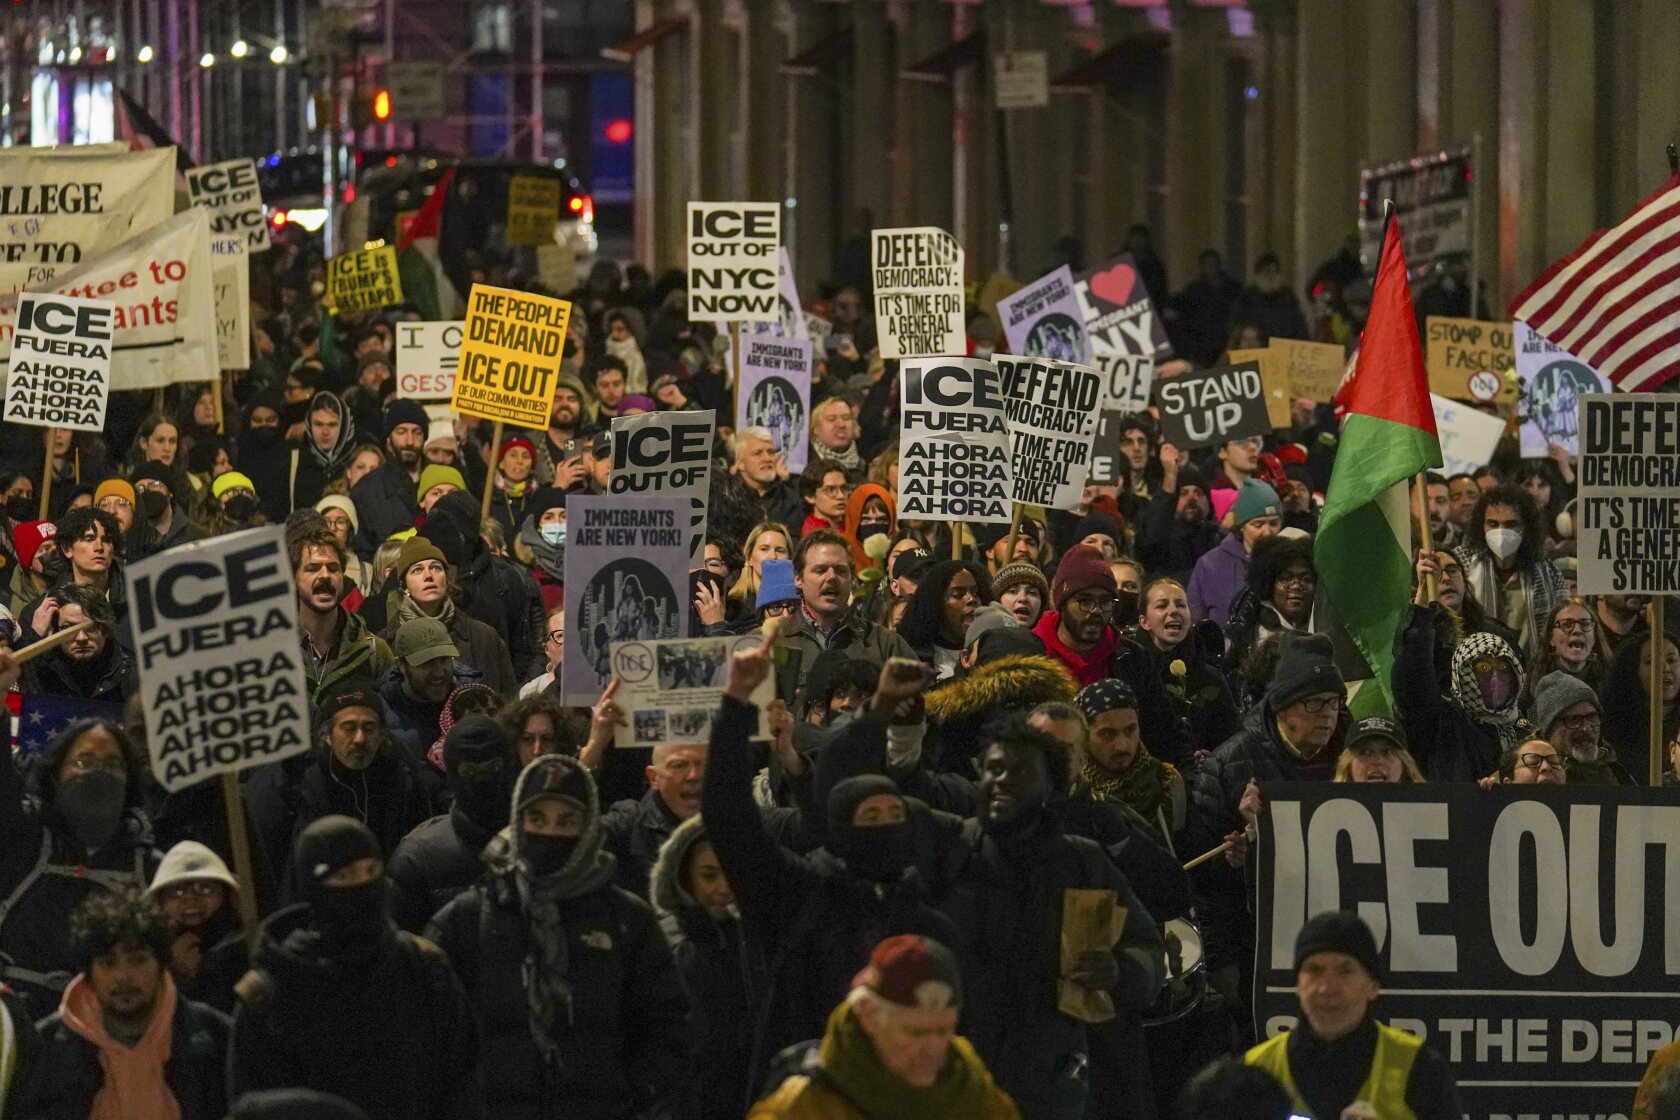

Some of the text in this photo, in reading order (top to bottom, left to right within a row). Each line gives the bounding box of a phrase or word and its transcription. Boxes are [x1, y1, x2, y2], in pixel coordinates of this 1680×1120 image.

[189, 164, 256, 197] ICE
[0, 182, 103, 216] LLEGE
[232, 189, 257, 203] OF
[692, 209, 777, 238] ICE
[692, 242, 776, 257] OUT OF
[877, 233, 958, 268] DEFEND
[27, 266, 55, 283] FOR
[149, 260, 186, 284] to
[333, 253, 370, 276] ICE
[692, 268, 776, 290] NYC
[875, 266, 959, 288] DEMOCRACY:
[475, 292, 566, 329] THE PEOPLE
[692, 295, 776, 313] NOW
[879, 294, 960, 316] IT'S TIME FOR
[18, 299, 112, 340] ICE
[889, 314, 953, 336] A GENERAL
[1088, 311, 1156, 355] NY
[1428, 322, 1482, 342] STOMP
[14, 335, 108, 360] FUERA
[469, 315, 560, 358] DEMAND
[751, 342, 803, 360] IMMIGRANTS
[898, 335, 945, 355] STRIKE!
[1522, 341, 1564, 353] ARE NE
[13, 361, 105, 382] AHORA
[462, 351, 554, 398] ICE OUT
[746, 355, 807, 372] ARE NEW YORK!
[9, 390, 101, 411] AHORA
[11, 376, 103, 397] AHORA
[458, 384, 548, 413] OF OUR COMMUNITIES!
[905, 365, 1004, 408] ICE
[998, 360, 1100, 412] DEFEND
[1160, 370, 1260, 415] STAND
[8, 404, 99, 426] AHORA
[904, 410, 1009, 435] FUERA
[1004, 397, 1093, 436] MOCRACY:
[1183, 402, 1242, 442] UP
[1586, 401, 1680, 455] DEFE
[613, 423, 711, 470] ICE
[904, 442, 1008, 463] AHORA
[1014, 430, 1089, 466] TIME FOR
[610, 466, 707, 495] OUT OF
[903, 460, 1008, 481] AHORA
[903, 478, 1007, 499] AHORA
[584, 509, 674, 527] IMMIGRANTS
[902, 496, 1007, 517] AHORA
[1584, 497, 1680, 529] IT'S TIME
[575, 528, 681, 546] ARE NEW YORK!
[1598, 529, 1612, 560] A
[134, 540, 290, 633] ICE
[1613, 560, 1680, 592] STRIK
[141, 607, 293, 670] FUERA
[153, 651, 296, 711] AHORA
[156, 676, 298, 736] AHORA
[160, 701, 300, 760] AHORA
[165, 726, 302, 785] AHORA
[1270, 798, 1458, 972] ICE
[1438, 1018, 1548, 1063] THE
[1562, 1018, 1680, 1063] DEP
